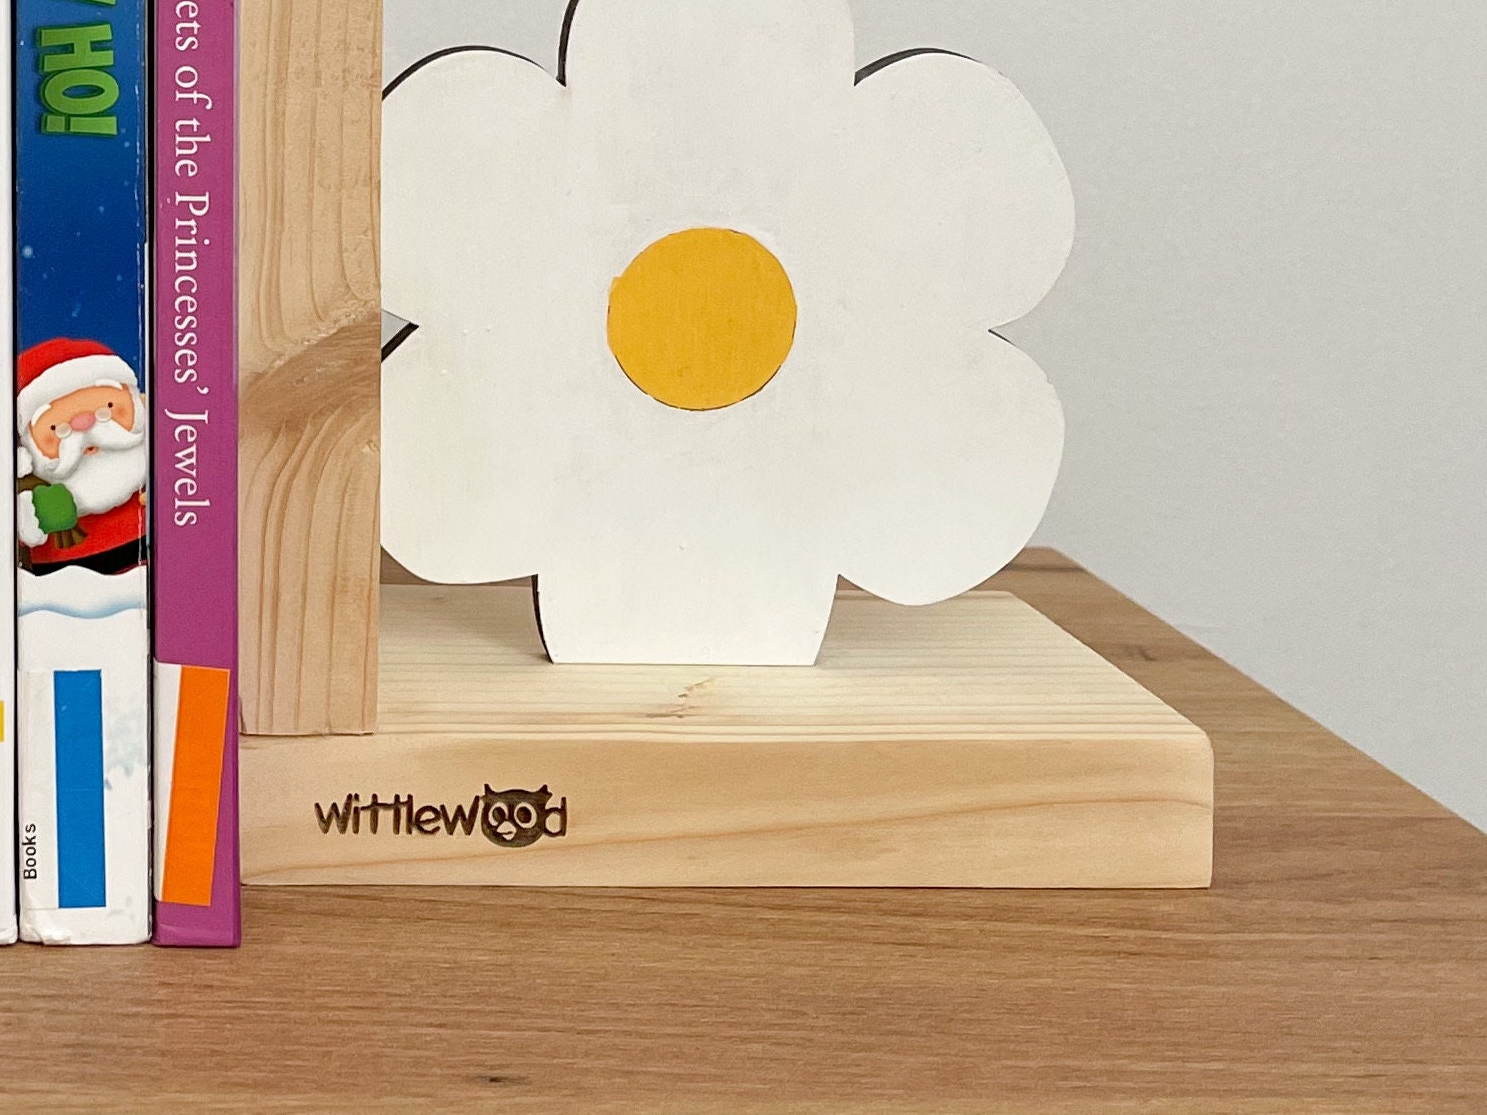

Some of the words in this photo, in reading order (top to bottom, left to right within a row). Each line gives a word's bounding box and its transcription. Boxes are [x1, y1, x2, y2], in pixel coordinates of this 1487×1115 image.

[35, 21, 120, 137] HO!
[174, 66, 212, 110] of
[174, 117, 212, 177] the
[173, 191, 211, 395] Princesses'
[164, 408, 211, 527] Jewels
[21, 822, 38, 880] Books
